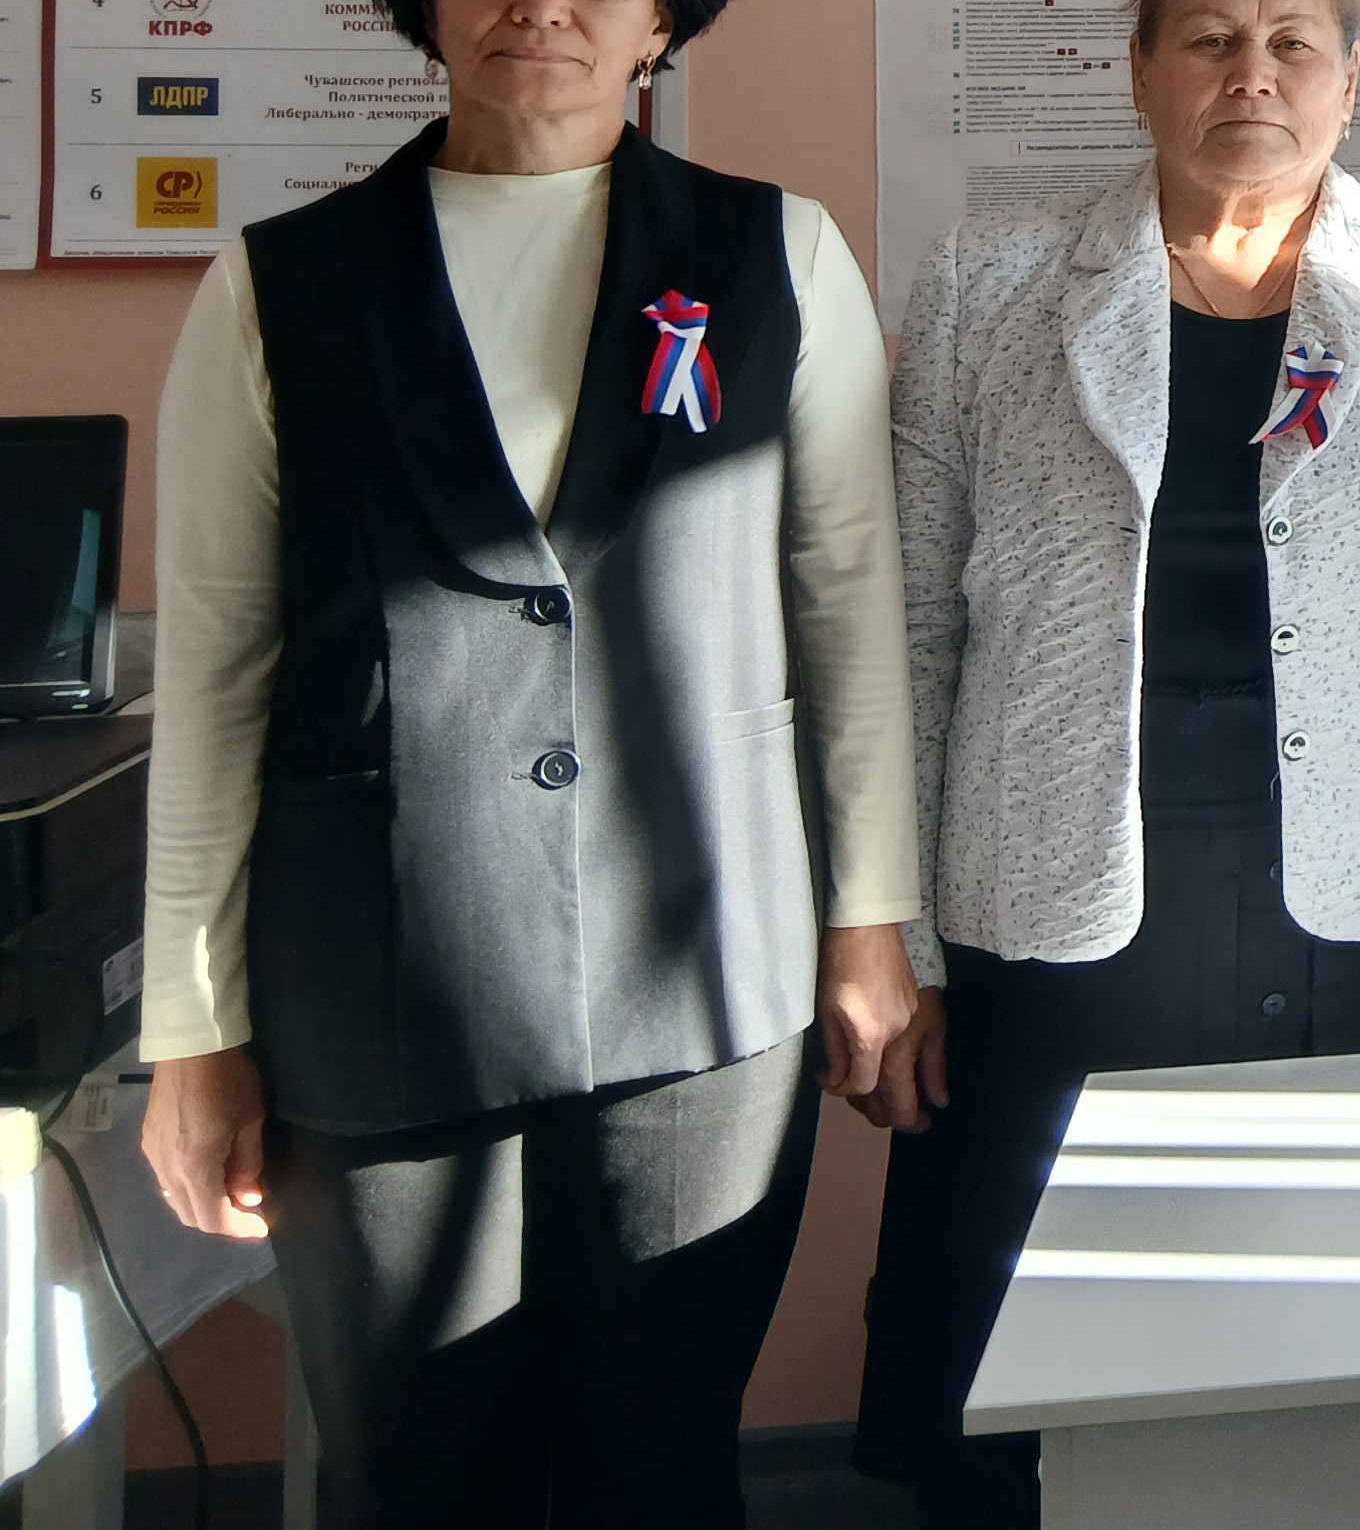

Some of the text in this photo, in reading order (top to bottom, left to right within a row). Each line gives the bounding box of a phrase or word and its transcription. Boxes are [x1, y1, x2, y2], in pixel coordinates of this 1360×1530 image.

[325, 3, 376, 16] КОММ
[148, 20, 213, 37] КПРФ
[304, 74, 385, 88] Чувашское
[90, 87, 103, 105] 5
[149, 85, 209, 110] ЛДПР
[328, 91, 435, 103] Политической
[265, 107, 355, 121] Либерально
[90, 184, 103, 201] 6
